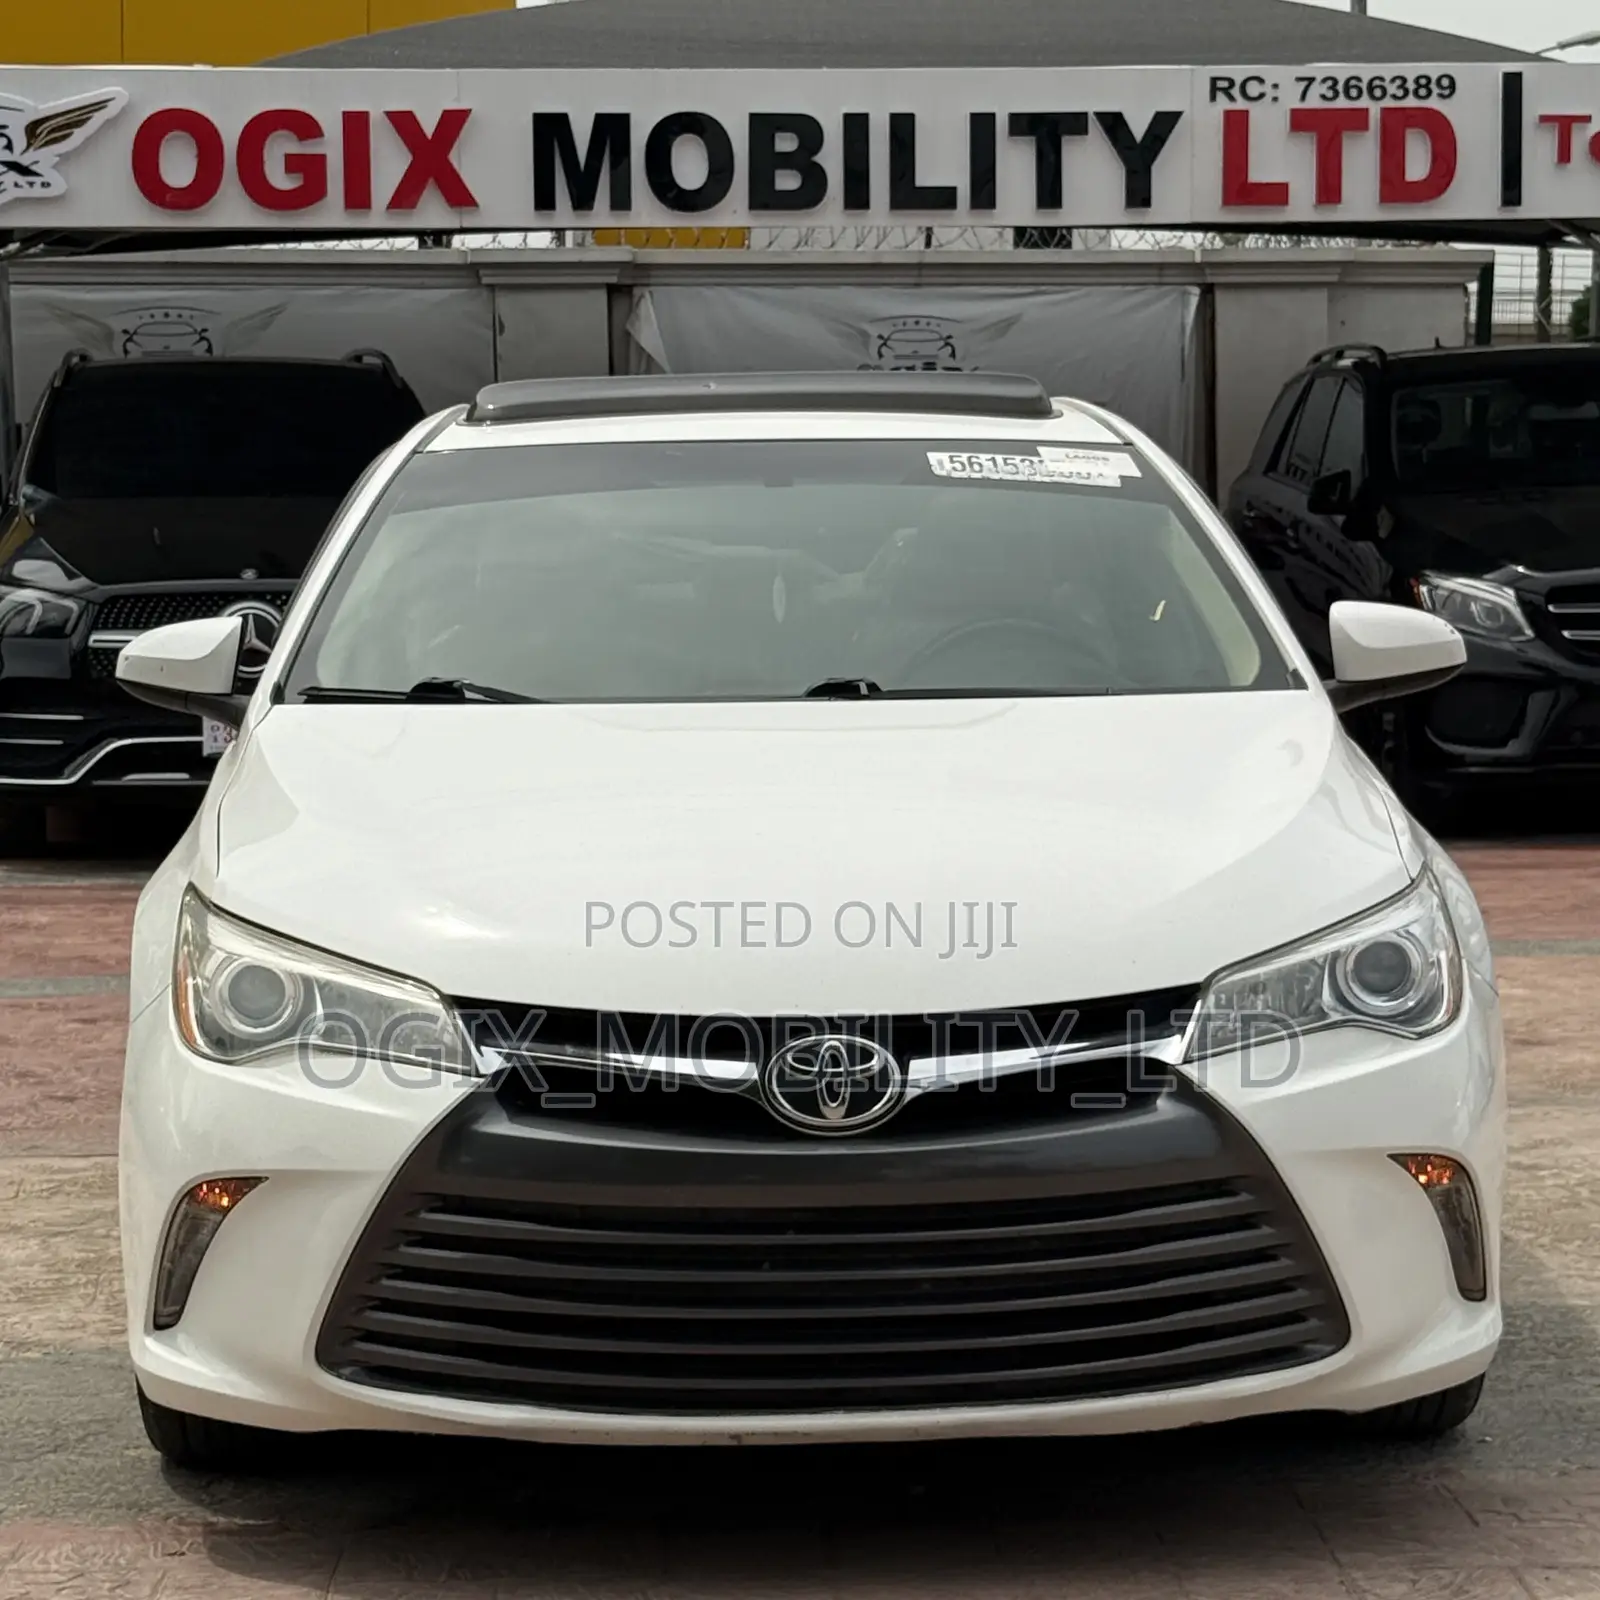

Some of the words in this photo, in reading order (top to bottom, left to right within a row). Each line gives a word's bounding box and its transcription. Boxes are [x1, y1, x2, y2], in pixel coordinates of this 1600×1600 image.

[1209, 75, 1280, 103] RC:
[1294, 74, 1457, 102] 7366389
[131, 107, 479, 211] OGIX
[532, 110, 1184, 213] MOBILITY
[1222, 106, 1457, 206] LTD
[1538, 114, 1600, 165] T
[13, 181, 52, 189] LTD
